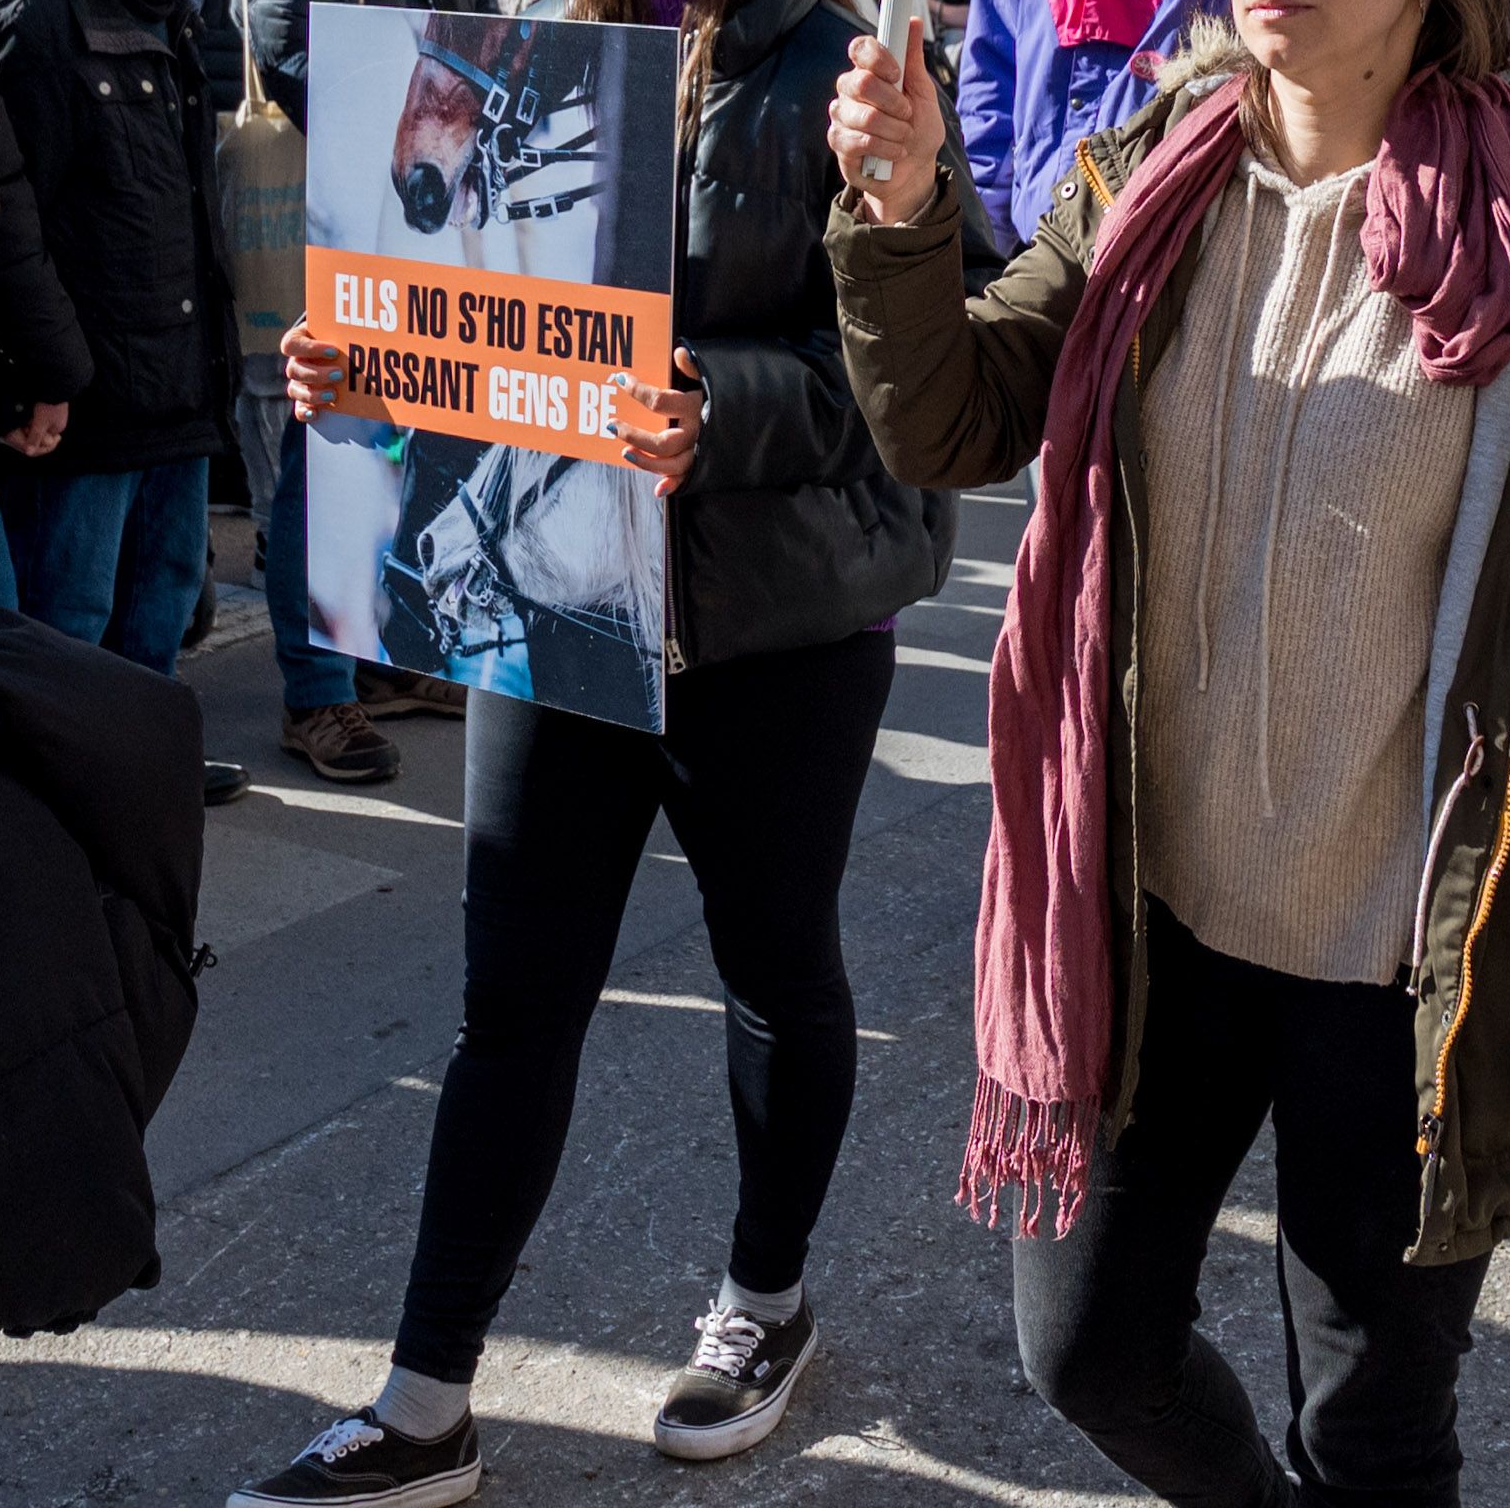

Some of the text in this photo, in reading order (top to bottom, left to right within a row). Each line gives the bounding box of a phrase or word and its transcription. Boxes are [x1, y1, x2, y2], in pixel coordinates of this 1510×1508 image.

[334, 273, 634, 368] ELLS NO S'HO ESTAN
[348, 343, 619, 440] PASSANT GENS BÉ
